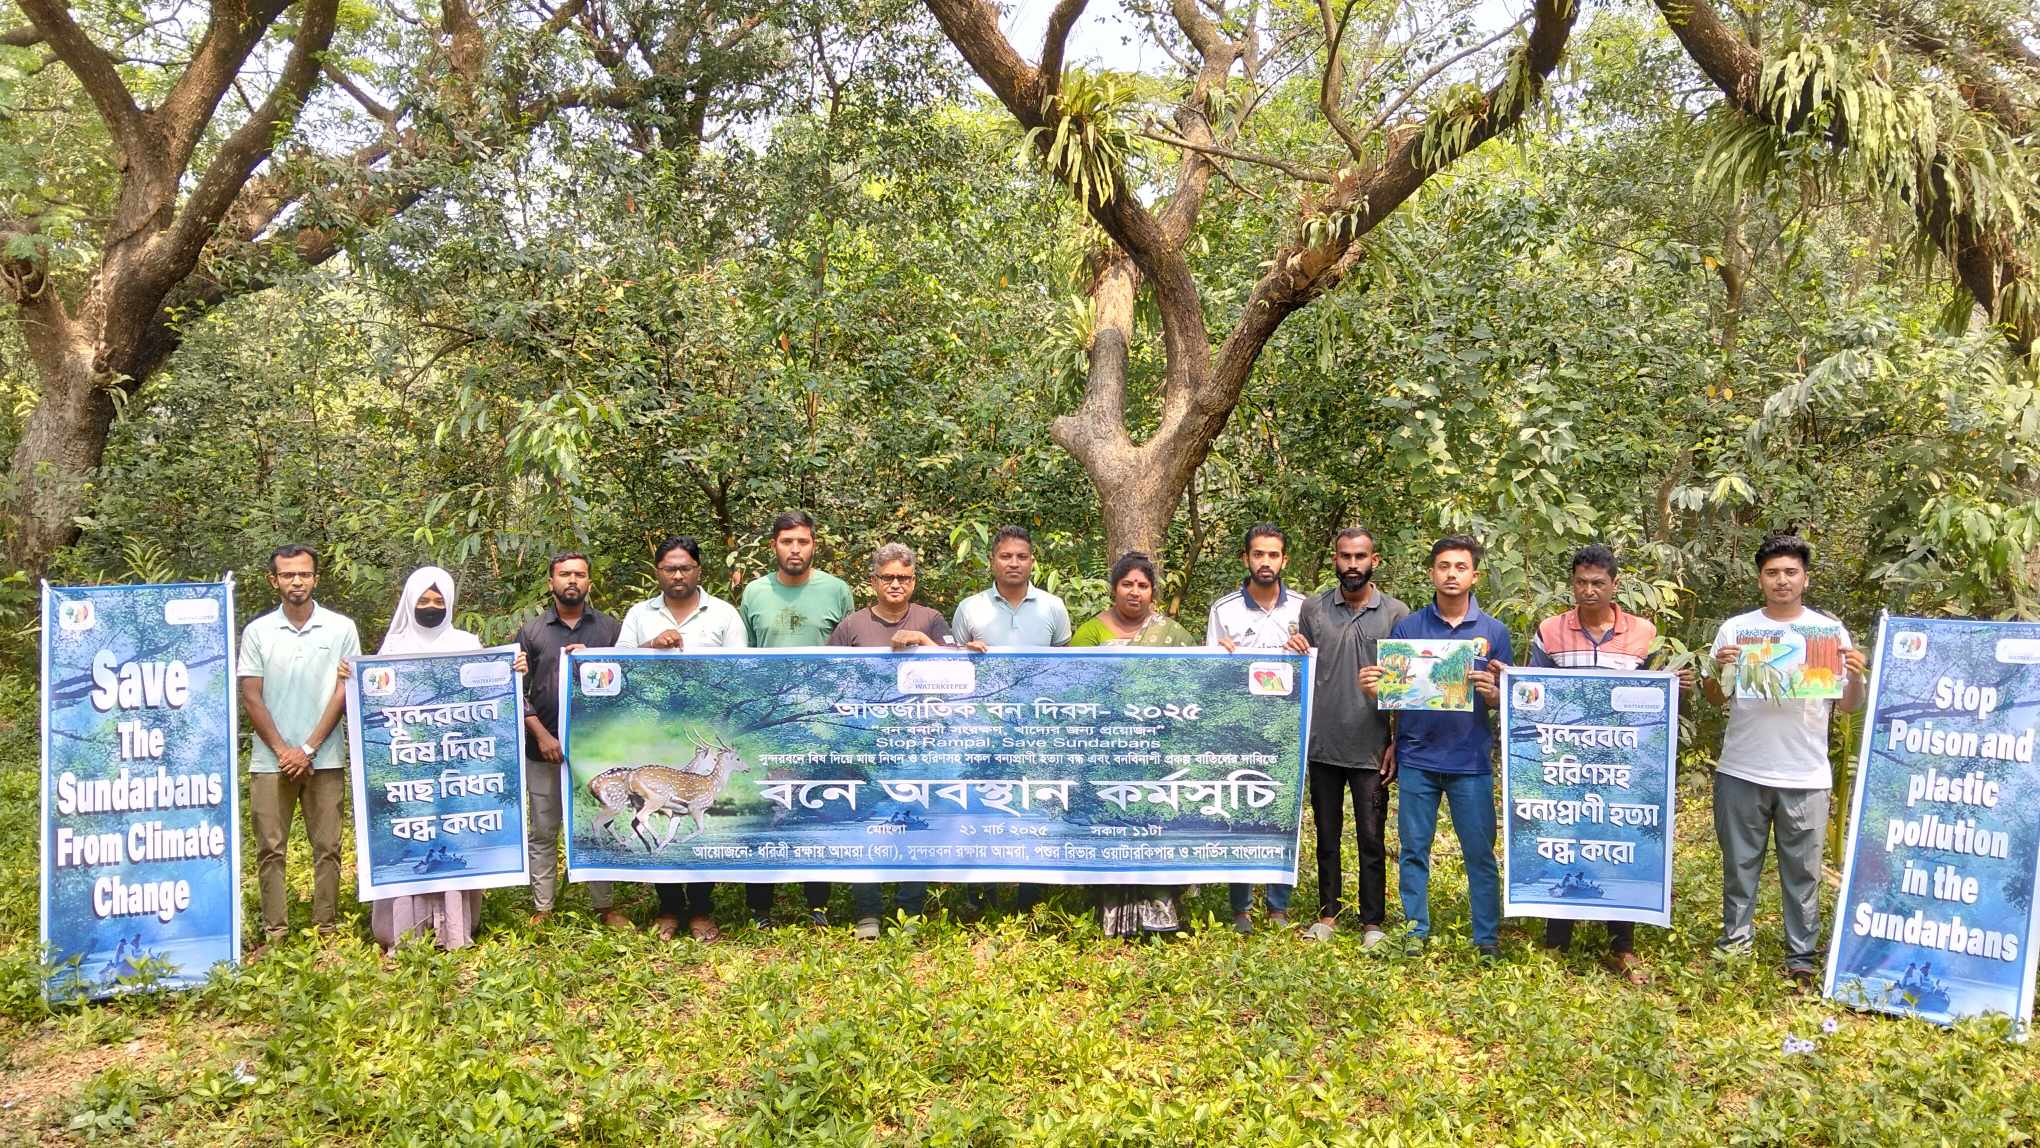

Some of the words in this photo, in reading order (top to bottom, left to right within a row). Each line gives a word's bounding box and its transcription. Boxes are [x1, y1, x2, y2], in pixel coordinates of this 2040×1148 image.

[90, 648, 190, 712] Save
[1934, 675, 1998, 720] Stop
[381, 700, 500, 738] সুন্দরবনে
[834, 697, 978, 719] আন্তর্জাতিক
[986, 702, 1024, 719] বন
[1124, 702, 1202, 721] ২০২৫
[118, 719, 165, 759] The
[876, 737, 918, 749] Stop
[923, 737, 996, 750] Rampal,
[1002, 737, 1047, 748] Save
[1053, 737, 1161, 748] Sundarbans
[1015, 724, 1060, 735] খাদ্যের
[1065, 724, 1094, 735] জন্য
[1535, 723, 1640, 754] সুন্দরবনে
[1887, 718, 1979, 758] Poison
[1981, 727, 2036, 763] and
[389, 734, 438, 766] বিষ
[440, 731, 497, 763] দিয়ে
[759, 752, 805, 766] সুন্দরবনে
[808, 751, 826, 764] বিষ
[830, 752, 853, 764] দিয়ে
[856, 754, 875, 764] মাছ
[879, 751, 904, 764] নিধন
[907, 755, 918, 764] ও
[921, 751, 961, 764] হরিণসহ
[965, 754, 991, 764] সকল
[994, 751, 1036, 765] বন্যপ্রাণী
[1038, 754, 1063, 764] হত্যা
[1066, 754, 1084, 765] বন্ধ
[1087, 754, 1110, 765] এবং
[1195, 751, 1239, 765] বাতিলের
[57, 765, 223, 815] Sundarbans
[384, 778, 434, 803] মাছ
[438, 769, 505, 799] নিধন
[1542, 755, 1631, 789] হরিণসহ
[1906, 767, 2001, 808] plastic
[752, 779, 867, 811] বনে
[876, 776, 1079, 817] অবস্থান
[1514, 793, 1606, 825] বন্যপ্রাণী
[1608, 803, 1660, 827] হত্যা
[56, 827, 123, 867] From
[127, 820, 226, 863] Climate
[391, 815, 437, 842] বন্ধ
[440, 809, 504, 835] করো
[866, 823, 906, 835] মোংলা
[959, 824, 977, 835] ২১
[982, 822, 1005, 835] মার্চ
[1009, 824, 1048, 837] ২০২৫
[1090, 825, 1127, 837] সকাল
[1132, 825, 1162, 837] ১১টা
[1885, 814, 2009, 859] pollution
[757, 842, 790, 859] ধরিত্রী
[794, 845, 824, 859] রক্ষায়
[828, 845, 863, 859] আমরা
[908, 845, 951, 861] সুন্দরবন
[1065, 842, 1096, 860] রিভার
[1101, 844, 1174, 860] ওয়াটারকিপার
[1178, 846, 1189, 858] ও
[1536, 837, 1577, 865] বন্ধ
[1579, 840, 1636, 865] করো
[93, 875, 191, 922] Change
[1900, 859, 1929, 897] in
[1933, 865, 1980, 904] the
[1853, 902, 2019, 962] Sundarbans
